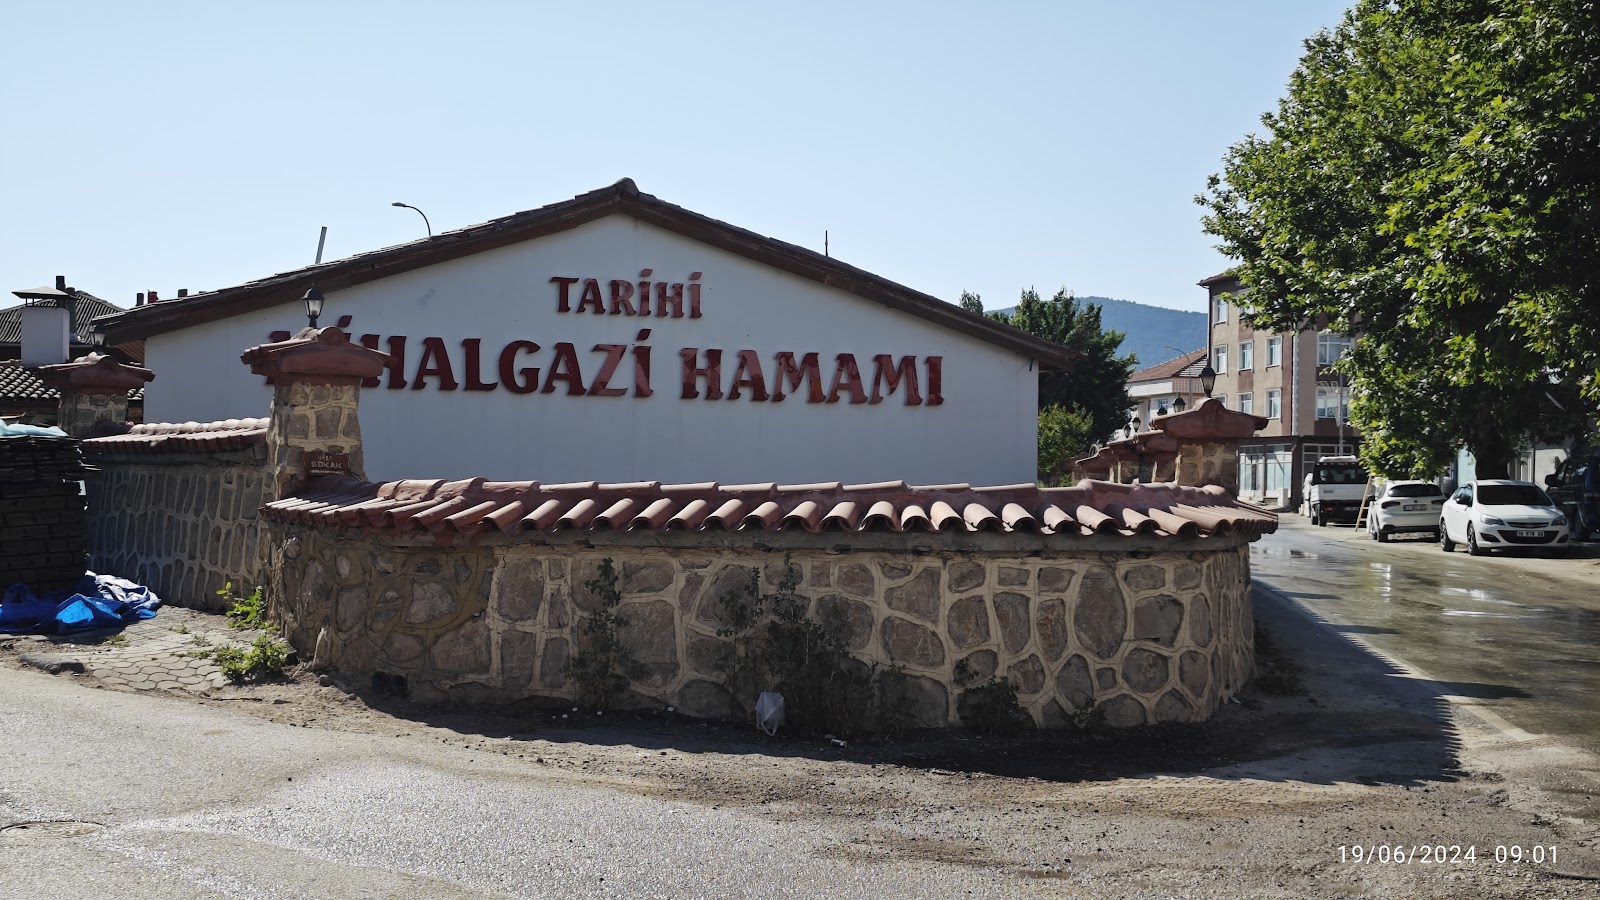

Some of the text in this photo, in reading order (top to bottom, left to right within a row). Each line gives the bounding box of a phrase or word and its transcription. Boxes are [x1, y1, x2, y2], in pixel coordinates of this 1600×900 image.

[549, 269, 703, 318] TARİHİ
[266, 315, 944, 407] HALGAZİ HAMAMI
[311, 460, 342, 469] SOKAK
